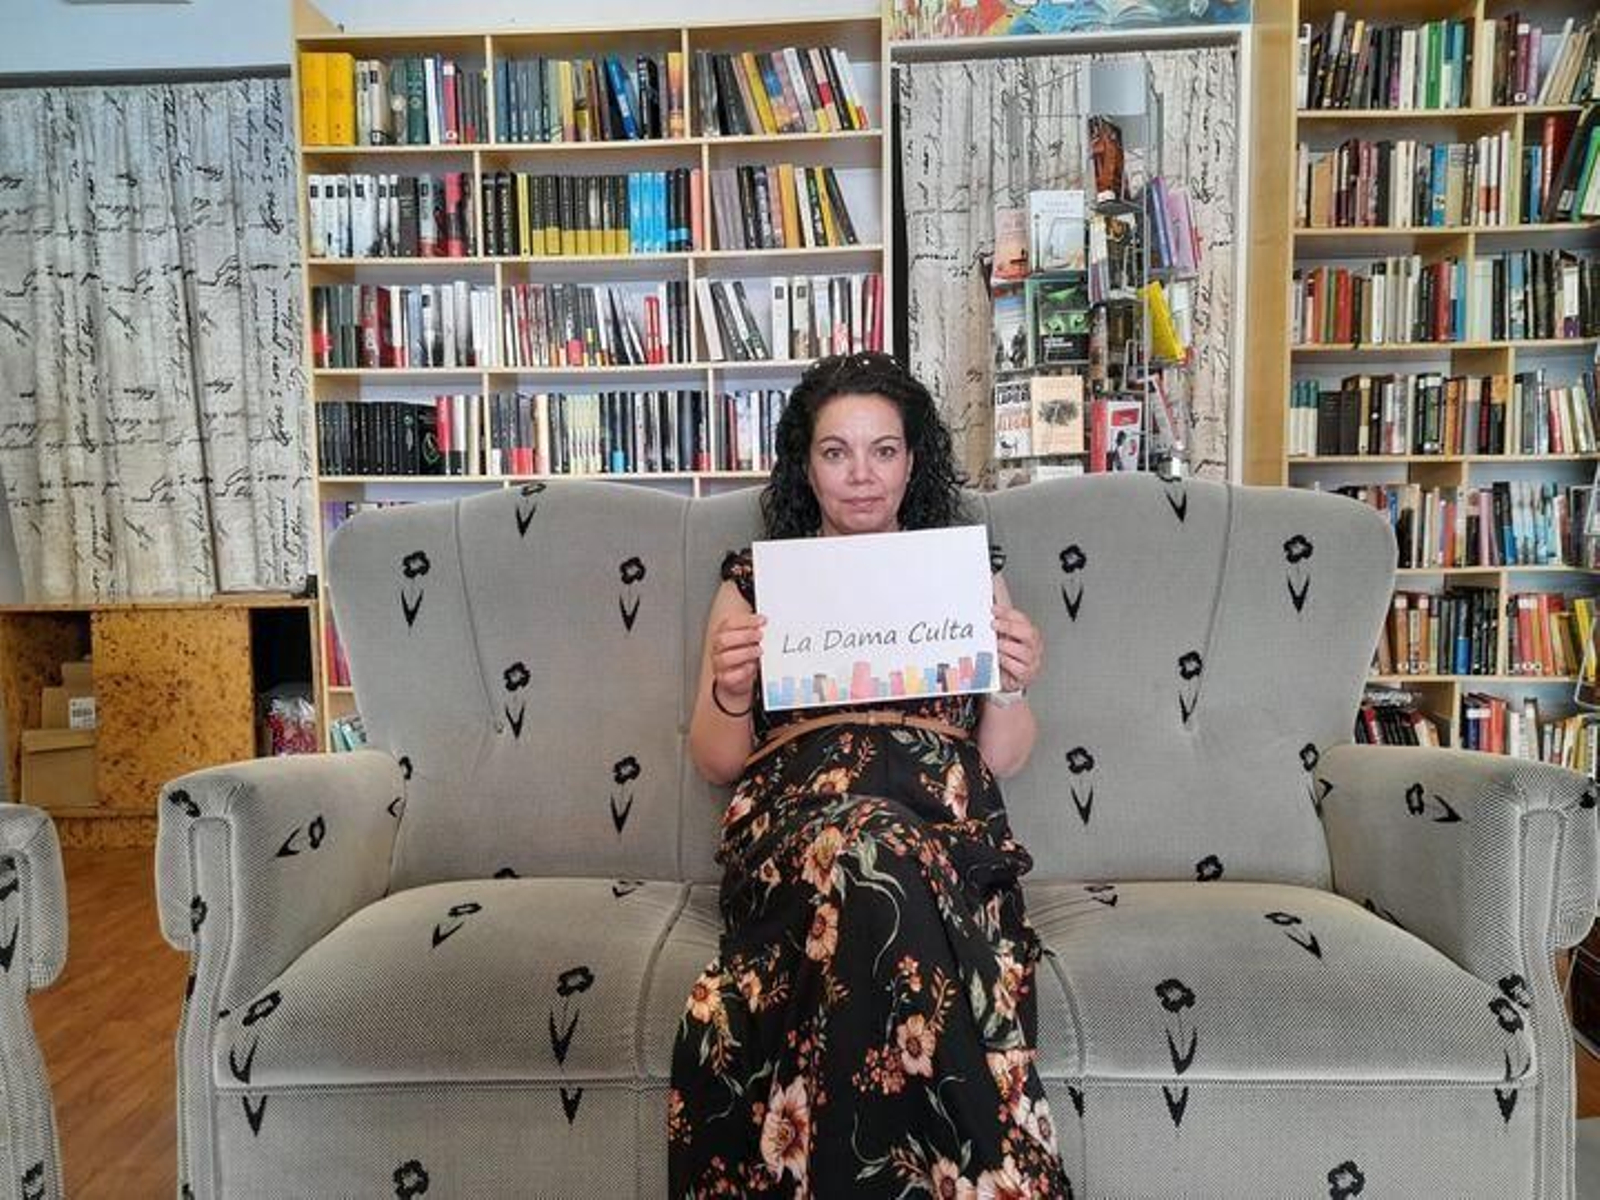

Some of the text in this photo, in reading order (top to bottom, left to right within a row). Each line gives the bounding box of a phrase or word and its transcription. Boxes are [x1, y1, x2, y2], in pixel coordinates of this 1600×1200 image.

[781, 618, 974, 655] La Dama Culta
